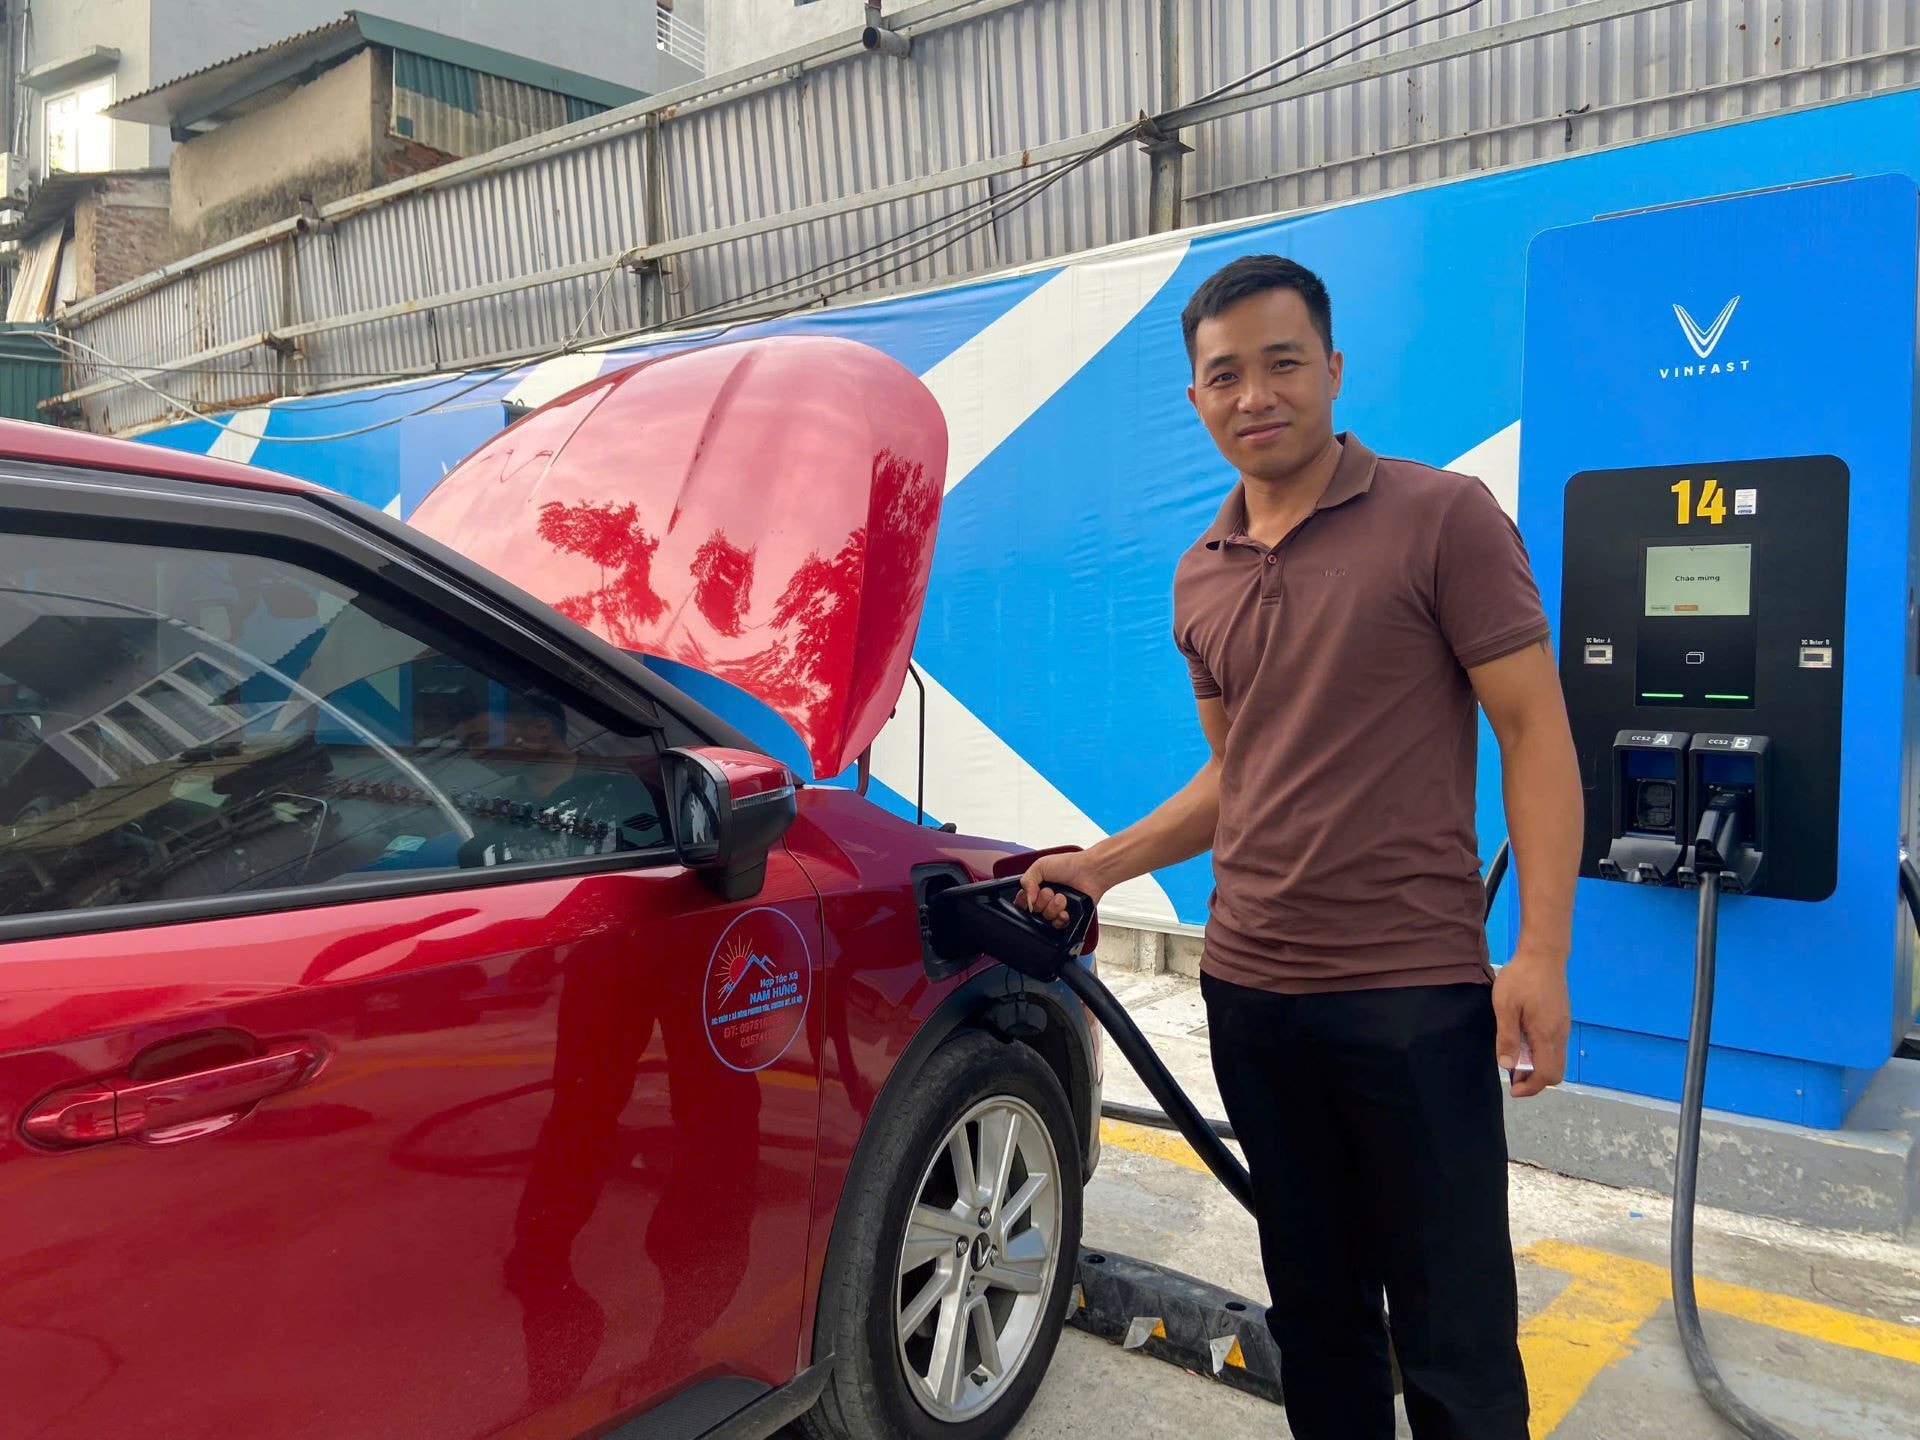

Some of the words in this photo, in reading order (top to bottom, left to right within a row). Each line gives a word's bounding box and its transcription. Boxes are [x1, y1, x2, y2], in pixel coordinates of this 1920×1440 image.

[1659, 360, 1750, 379] VINFAST
[1671, 479, 1727, 525] 14
[750, 989, 770, 1004] NAM
